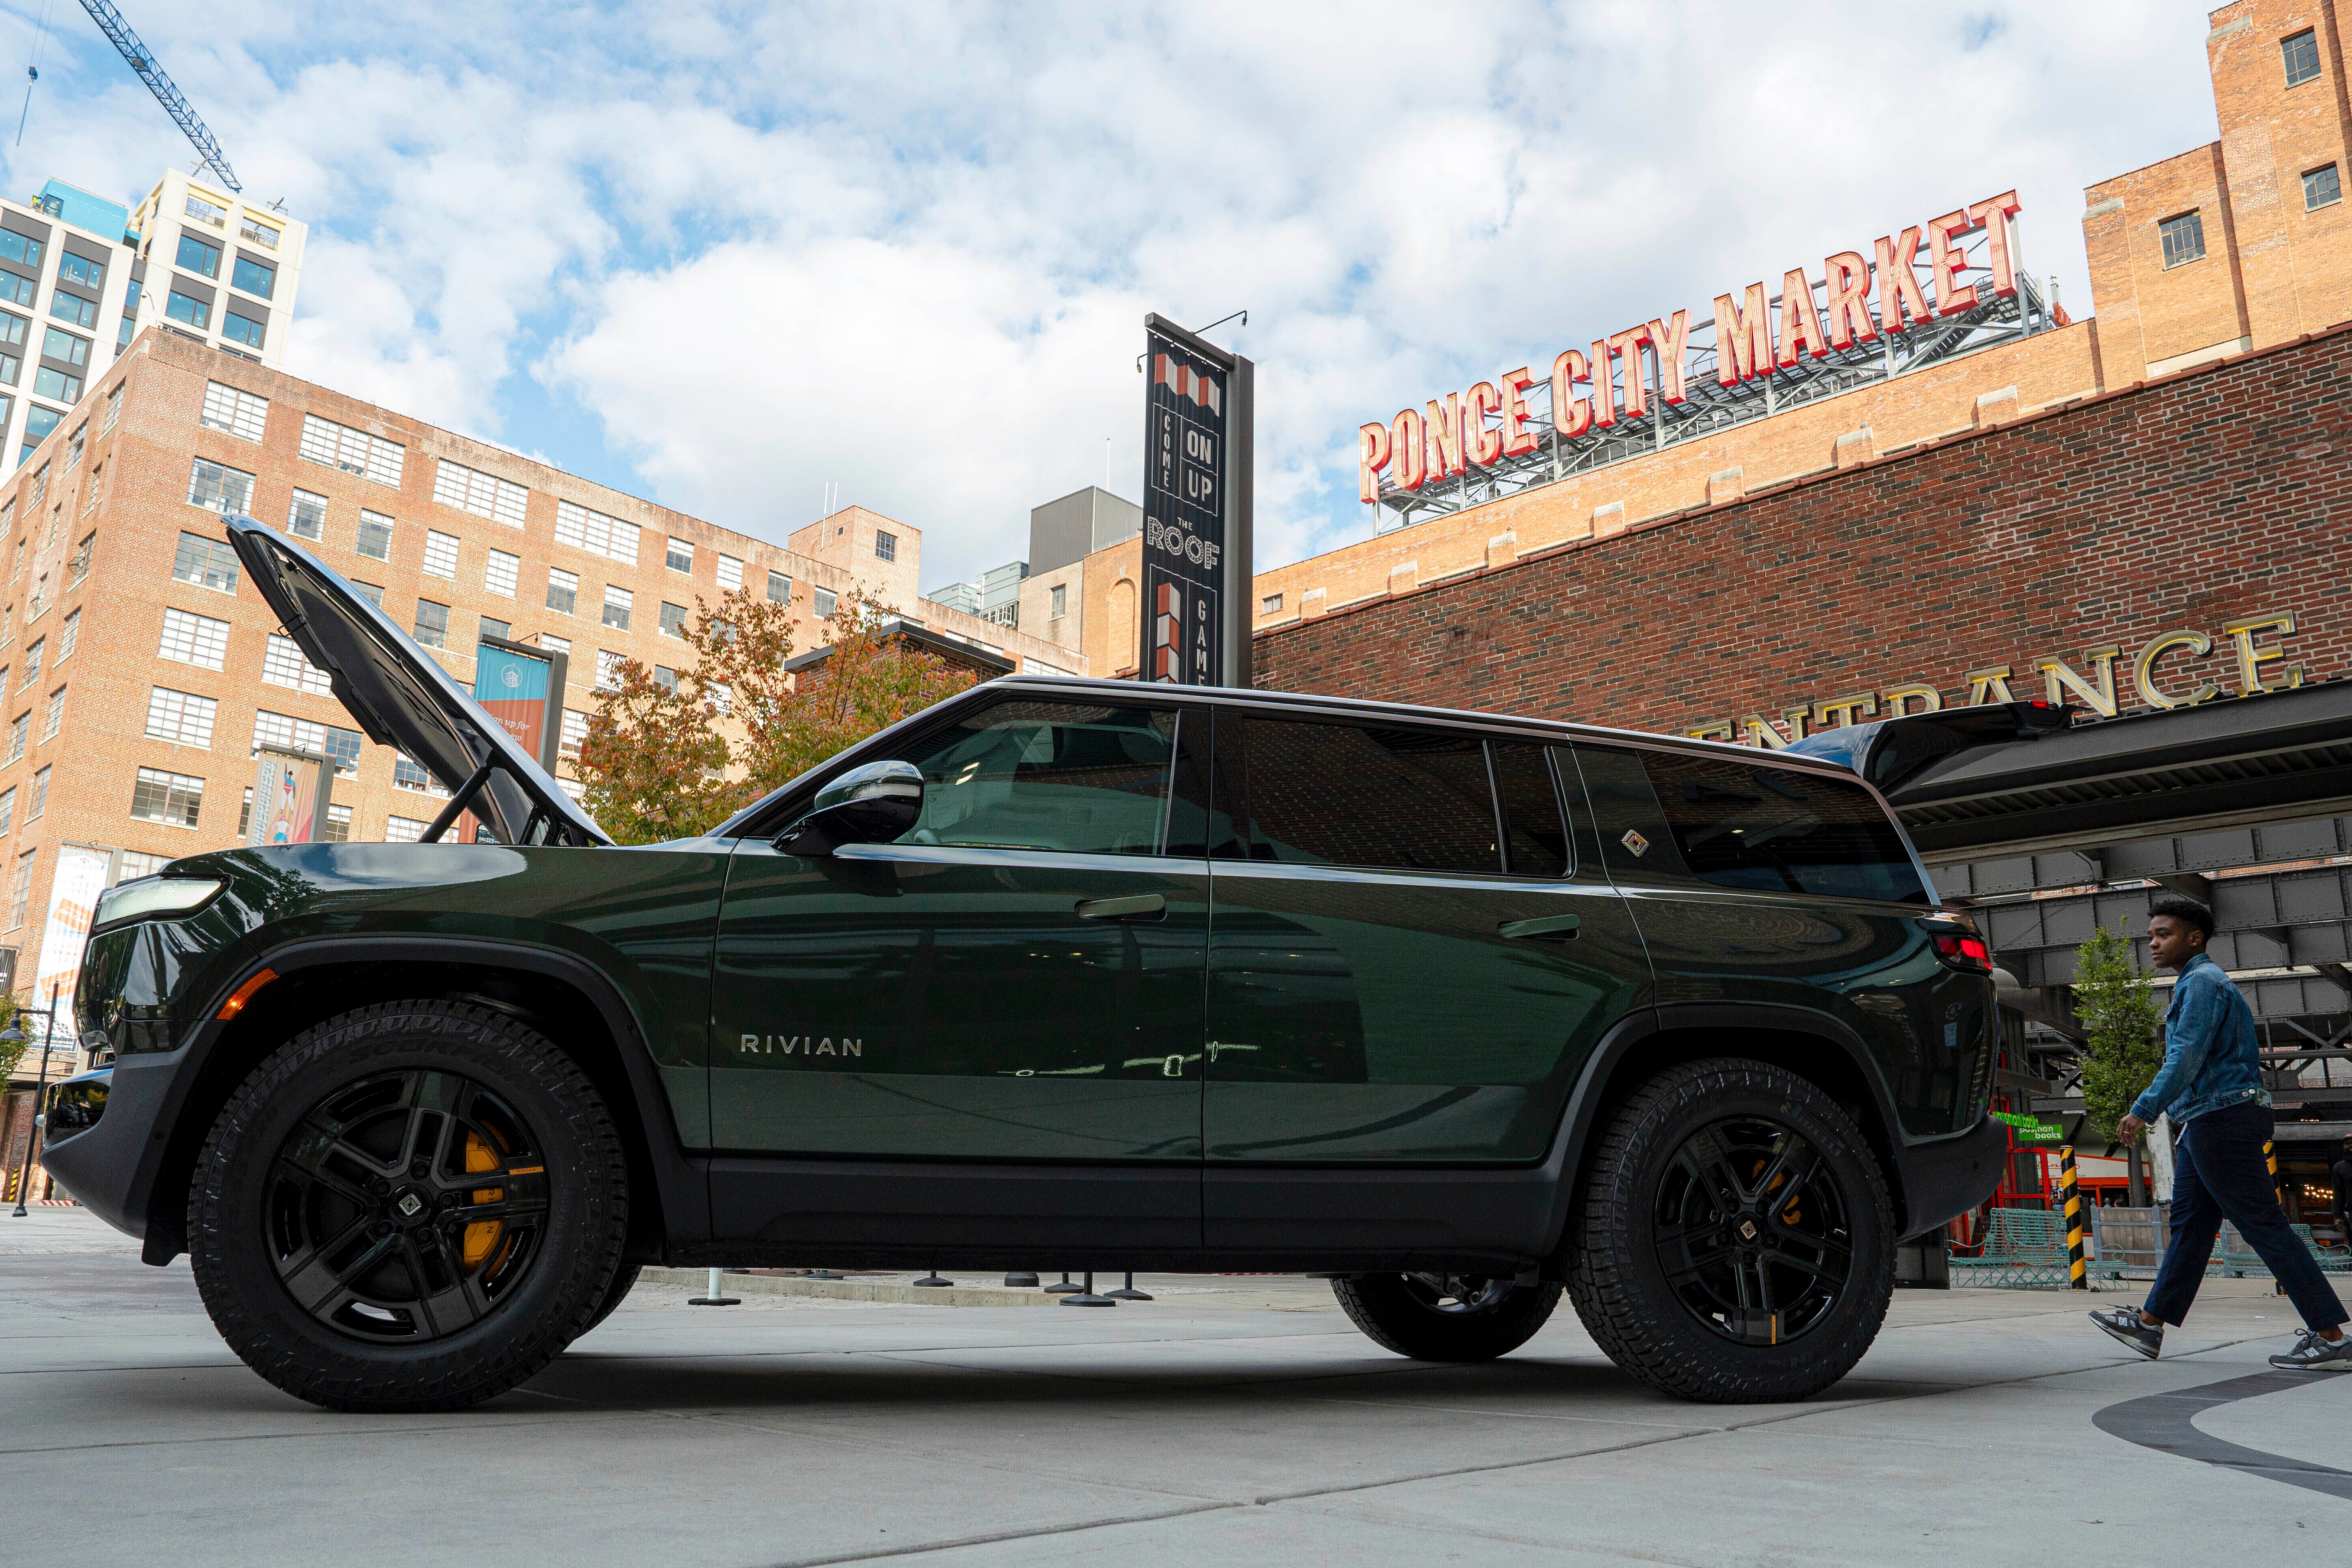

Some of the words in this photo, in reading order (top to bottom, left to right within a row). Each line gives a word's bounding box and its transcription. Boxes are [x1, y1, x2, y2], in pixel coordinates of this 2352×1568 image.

[1359, 365, 1539, 504] PONCE
[1552, 309, 1692, 438] CITY
[1714, 189, 2022, 388] MARKET
[1187, 430, 1211, 464] ON
[1188, 469, 1212, 503] UP
[1178, 517, 1192, 531] THE
[1147, 516, 1219, 569] ROOF
[505, 719, 516, 728] up
[516, 721, 530, 730] for
[252, 760, 276, 846] ONCERCISERS
[741, 1034, 862, 1056] RIVIAN
[2021, 1114, 2039, 1129] books
[2119, 1317, 2127, 1326] N
[2304, 1347, 2320, 1358] N
